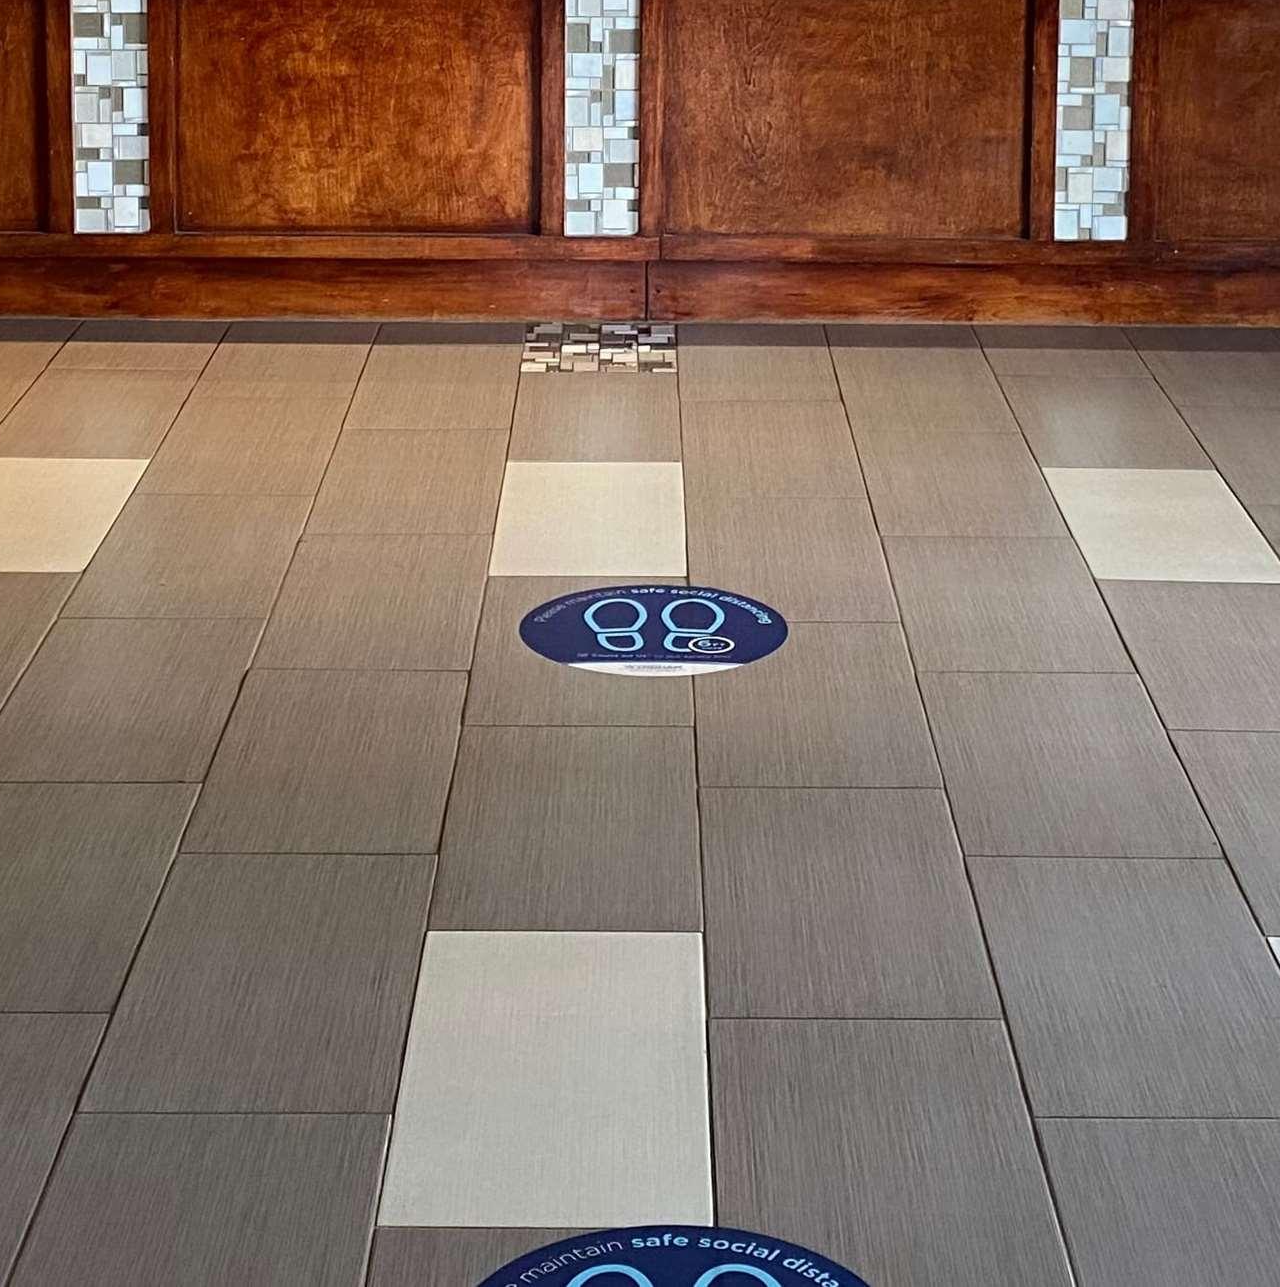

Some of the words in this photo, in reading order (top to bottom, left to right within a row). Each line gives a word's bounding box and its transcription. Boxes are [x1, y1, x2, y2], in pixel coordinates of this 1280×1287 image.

[670, 589, 718, 599] social
[719, 594, 772, 625] distancing
[520, 1240, 624, 1284] maintain
[631, 1233, 689, 1248] safe
[698, 1237, 781, 1262] social
